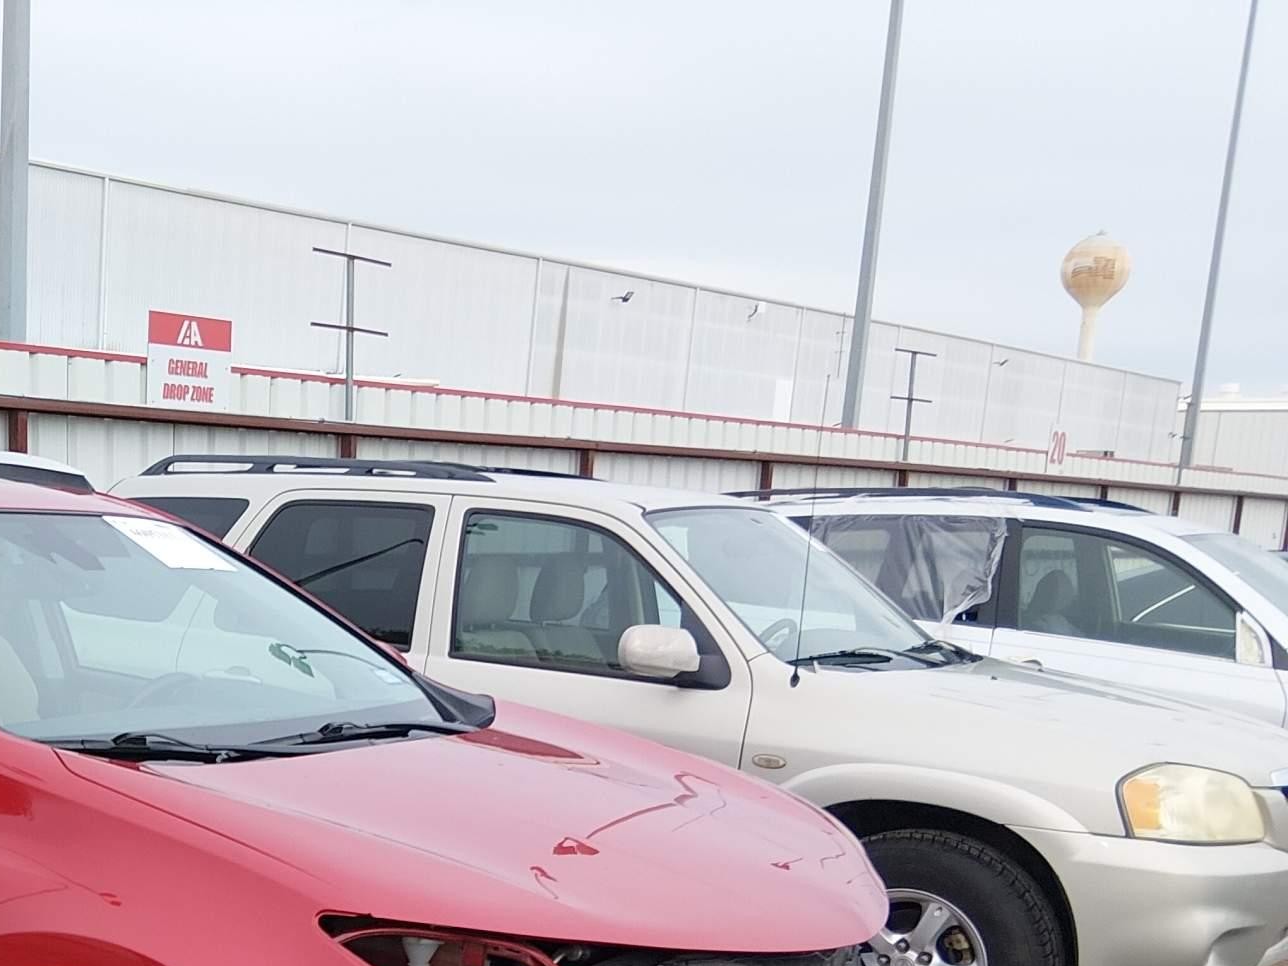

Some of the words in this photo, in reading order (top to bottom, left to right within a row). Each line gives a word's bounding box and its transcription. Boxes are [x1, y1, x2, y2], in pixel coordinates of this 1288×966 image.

[167, 358, 209, 379] GENERAL
[162, 382, 190, 401] DROP
[190, 385, 215, 404] ZONE
[1048, 430, 1067, 465] 20
